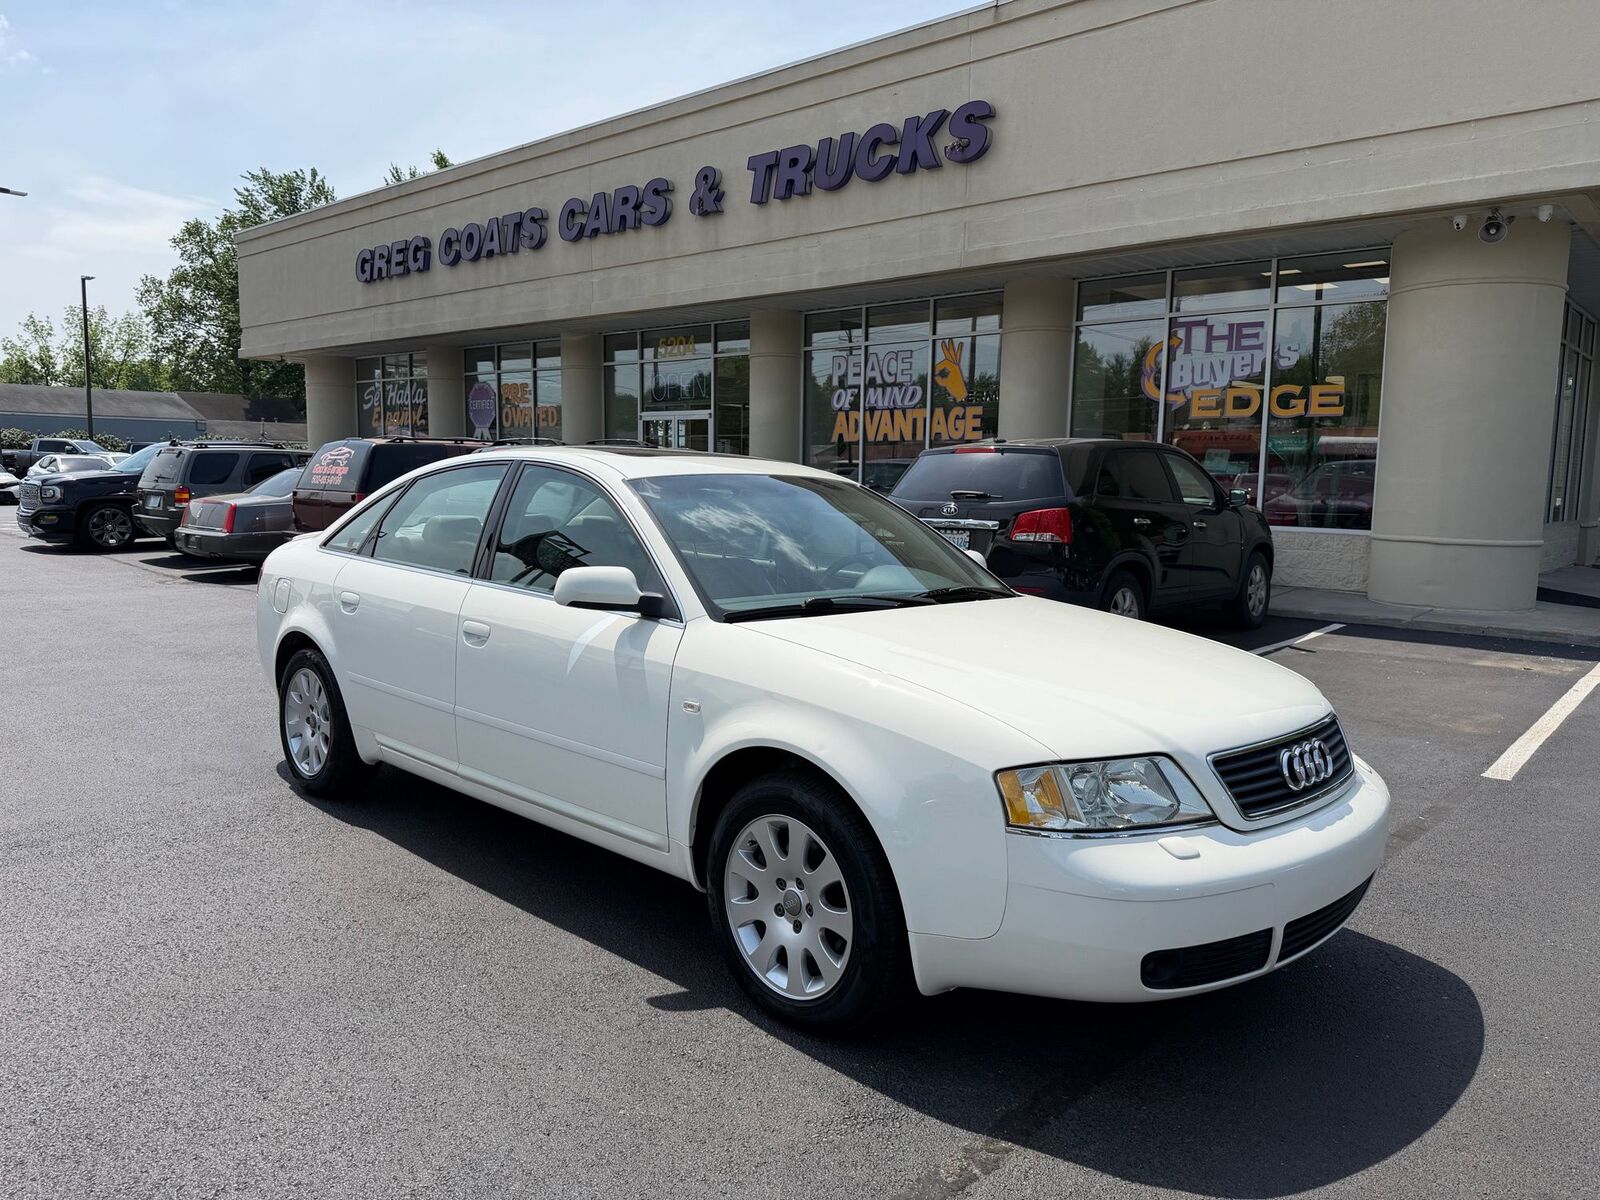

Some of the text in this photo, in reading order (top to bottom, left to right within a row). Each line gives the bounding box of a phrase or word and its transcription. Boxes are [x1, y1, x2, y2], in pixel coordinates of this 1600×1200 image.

[355, 99, 996, 283] GREG COATS CARS & TRUCKS
[658, 336, 696, 357] 5204
[1172, 317, 1264, 355] THE
[652, 371, 707, 401] OPEN
[832, 351, 913, 387] PEACE
[386, 382, 427, 406] Habla
[831, 385, 923, 410] OF MIND
[1189, 384, 1345, 420] EDGE
[831, 406, 983, 443] ADVANTAGE
